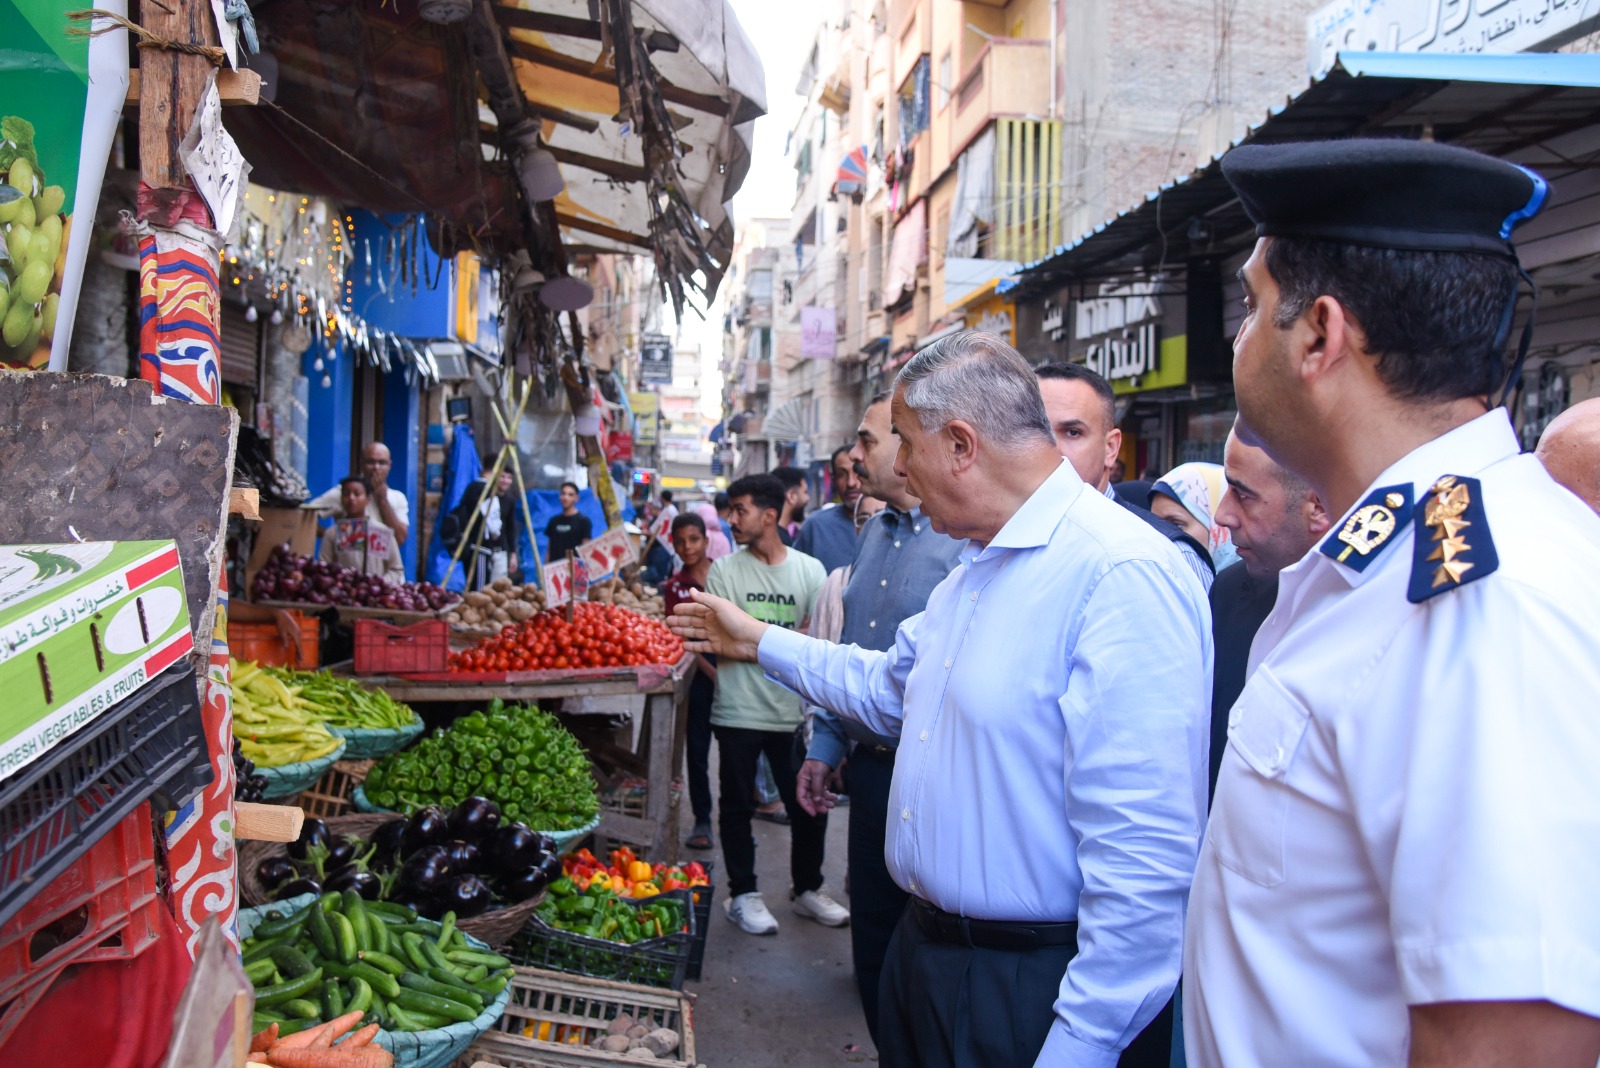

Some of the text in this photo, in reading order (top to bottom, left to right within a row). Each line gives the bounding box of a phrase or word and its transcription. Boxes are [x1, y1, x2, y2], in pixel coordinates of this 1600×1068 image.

[76, 580, 124, 614] خضروات
[0, 668, 145, 774] FRESH VEGETABLES & FRUITS
